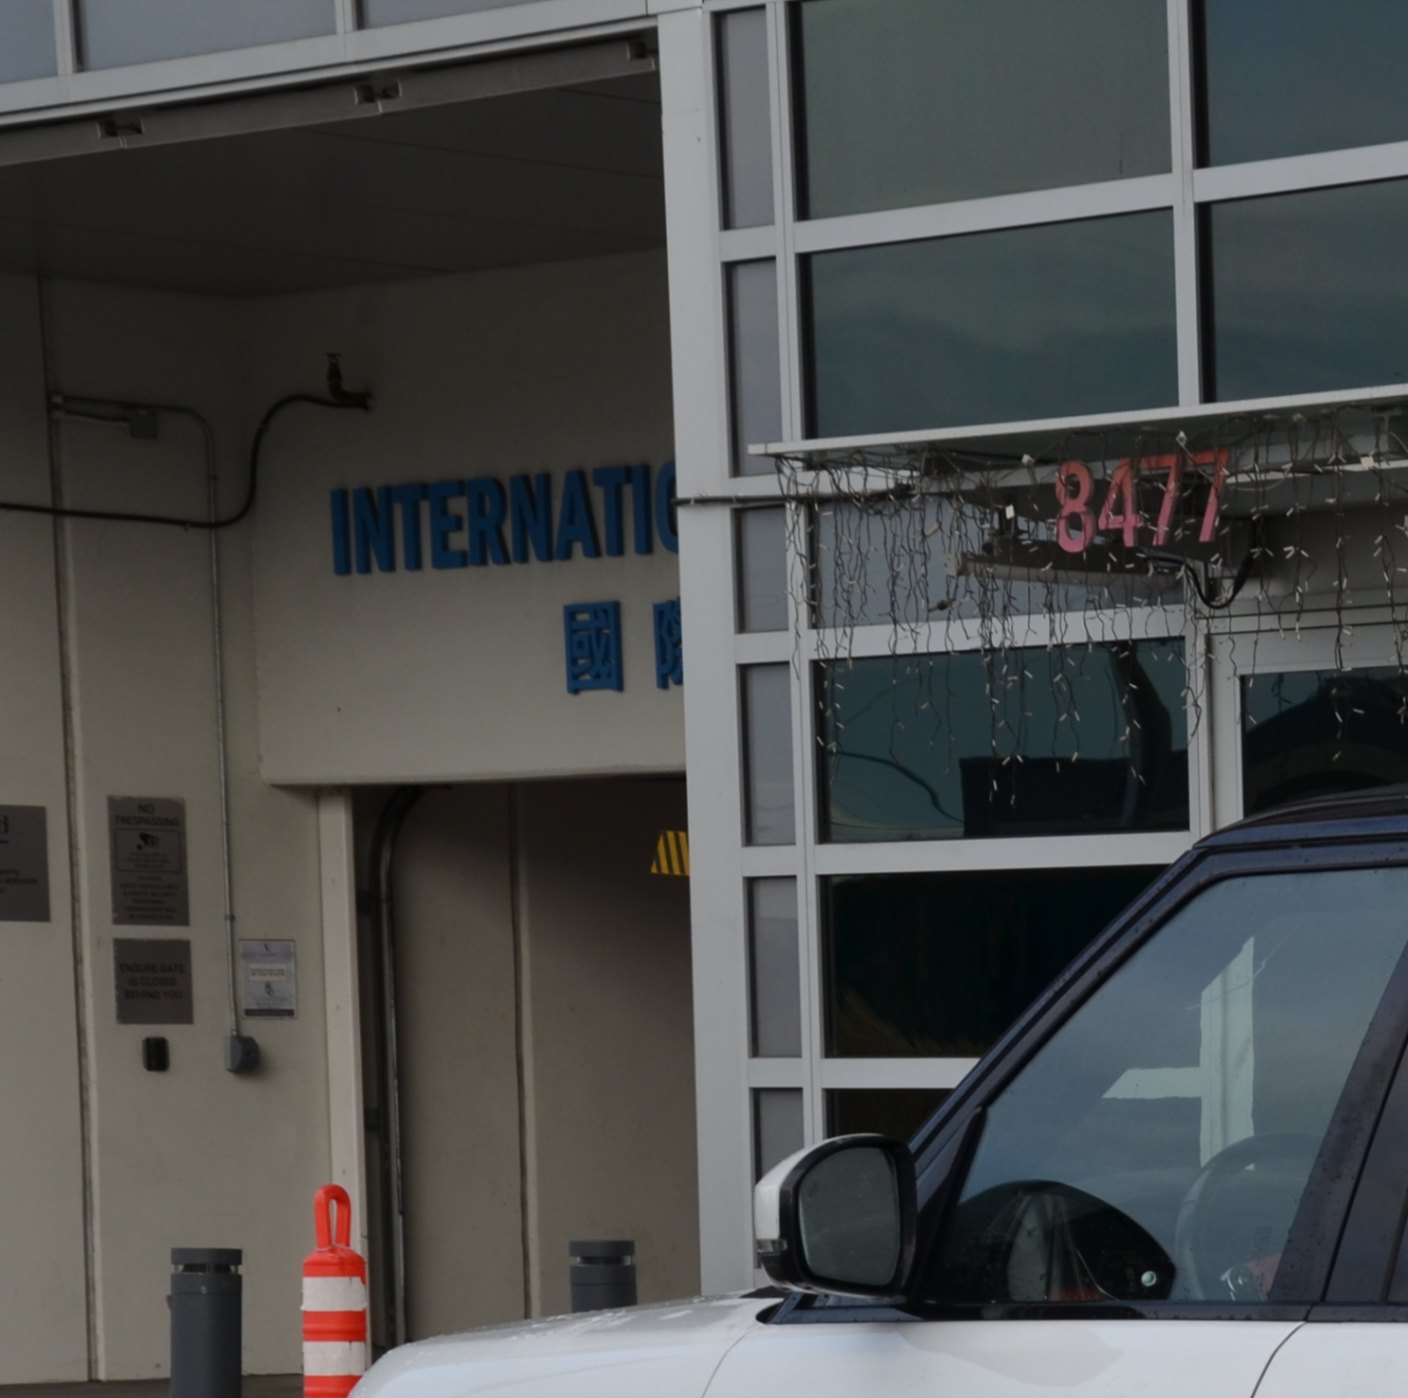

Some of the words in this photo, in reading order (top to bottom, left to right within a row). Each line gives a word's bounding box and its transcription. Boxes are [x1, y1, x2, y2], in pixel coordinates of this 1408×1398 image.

[1055, 448, 1230, 554] 8477
[138, 803, 155, 814] NO
[115, 815, 181, 827] TRESPASSING
